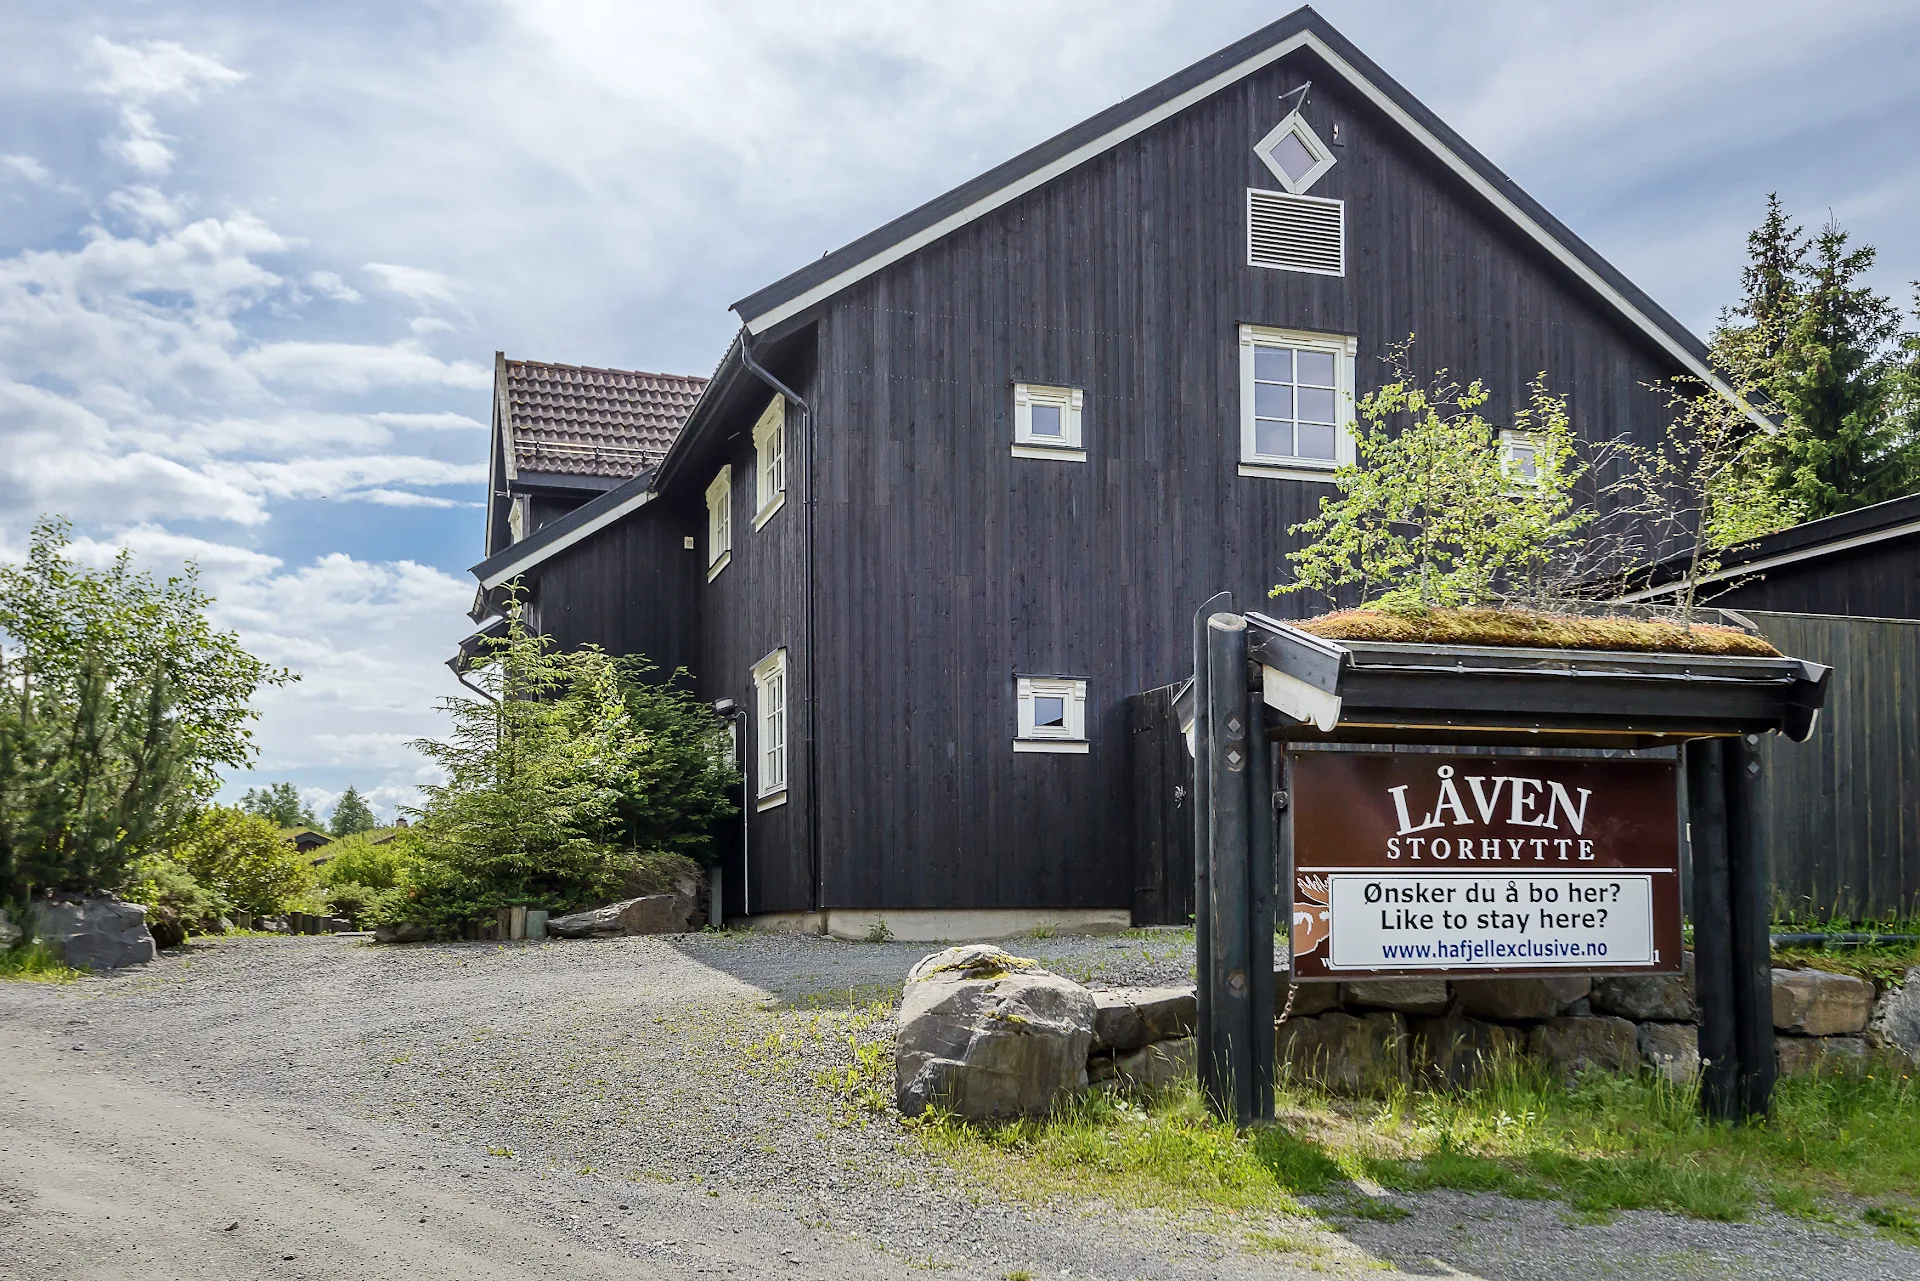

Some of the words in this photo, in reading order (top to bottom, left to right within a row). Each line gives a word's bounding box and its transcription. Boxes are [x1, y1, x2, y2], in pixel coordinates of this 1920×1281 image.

[1387, 764, 1592, 836] LÅVEN
[1386, 837, 1595, 861] STORHYTTE
[1363, 881, 1457, 905] Ønsker
[1465, 882, 1495, 903] du
[1505, 880, 1519, 903] å
[1529, 882, 1559, 903] bo
[1568, 882, 1621, 903] her?
[1381, 908, 1434, 930] Like
[1442, 910, 1468, 930] to
[1476, 909, 1530, 934] stay
[1539, 908, 1608, 929] here?
[1382, 939, 1608, 963] www.hafjellexclusive.no
